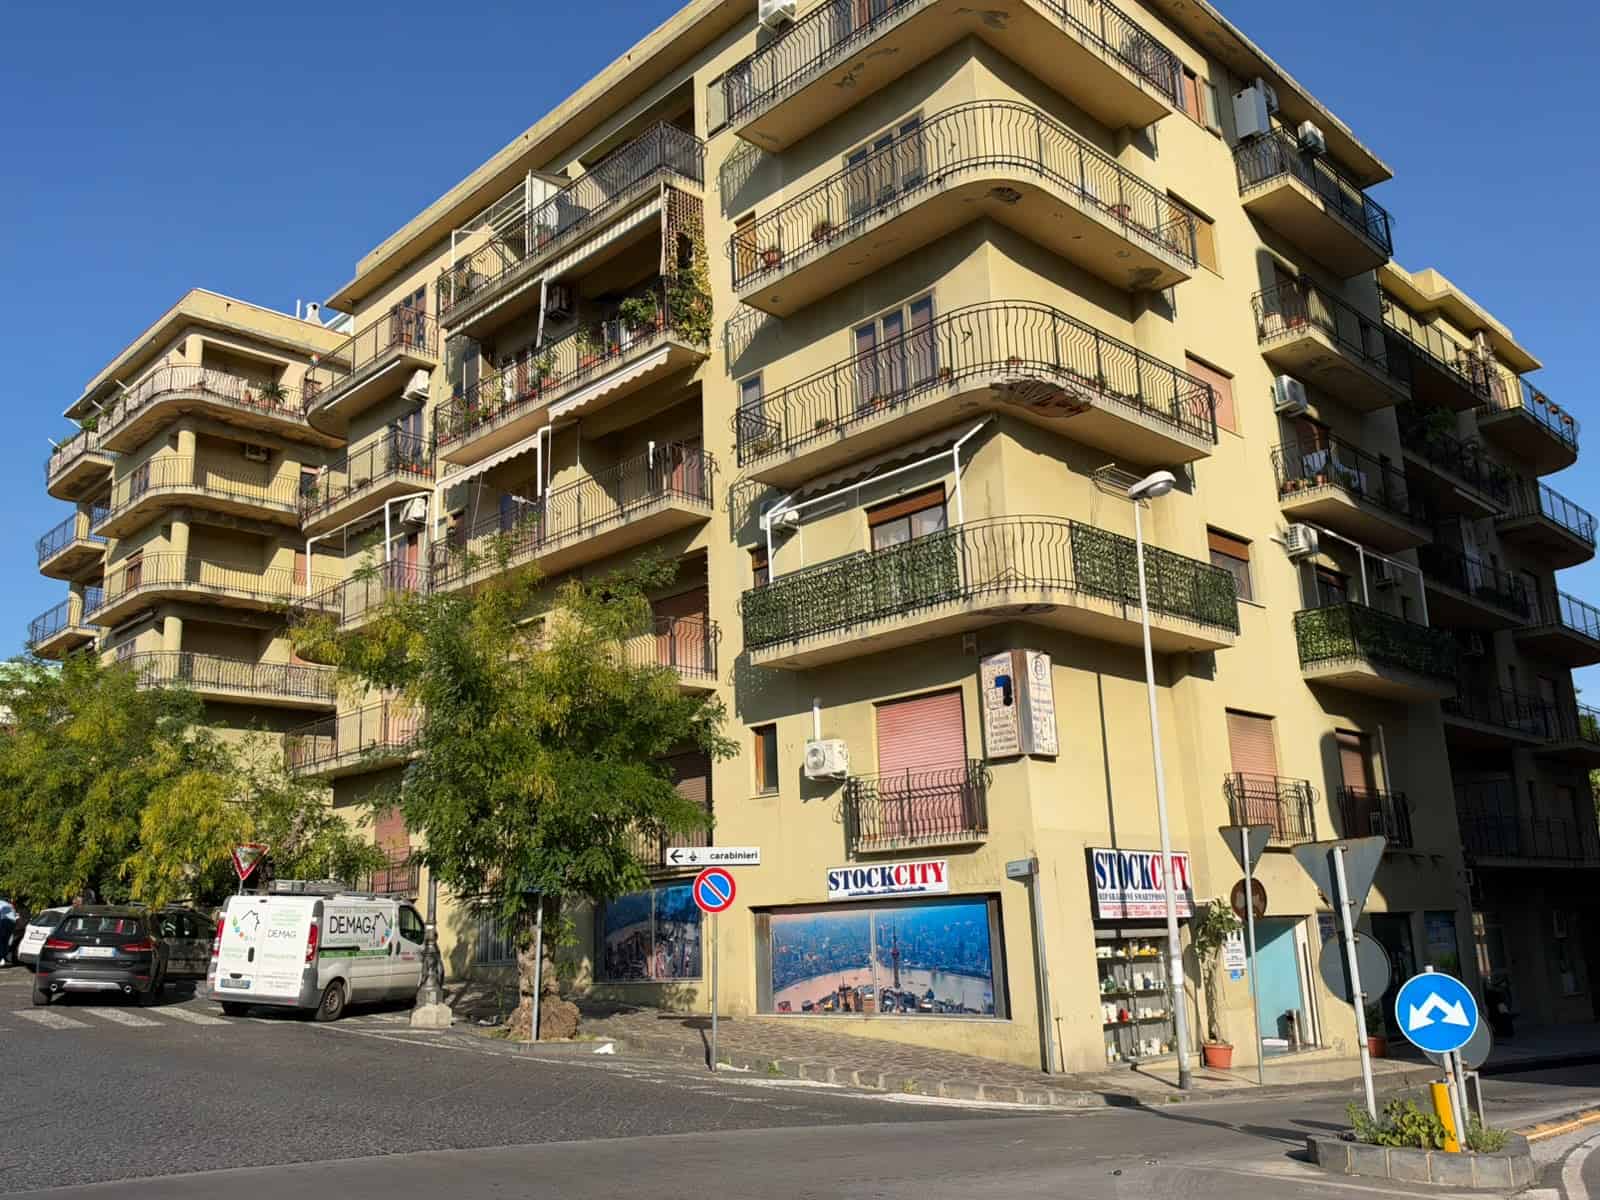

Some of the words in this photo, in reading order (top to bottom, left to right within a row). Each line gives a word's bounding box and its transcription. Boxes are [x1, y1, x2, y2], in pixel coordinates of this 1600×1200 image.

[710, 851, 758, 860] carabinieri
[828, 861, 945, 891] STOCKCITY
[1095, 852, 1188, 891] STOCKCTY
[267, 928, 297, 938] DEMAG
[329, 915, 373, 935] DEMAG
